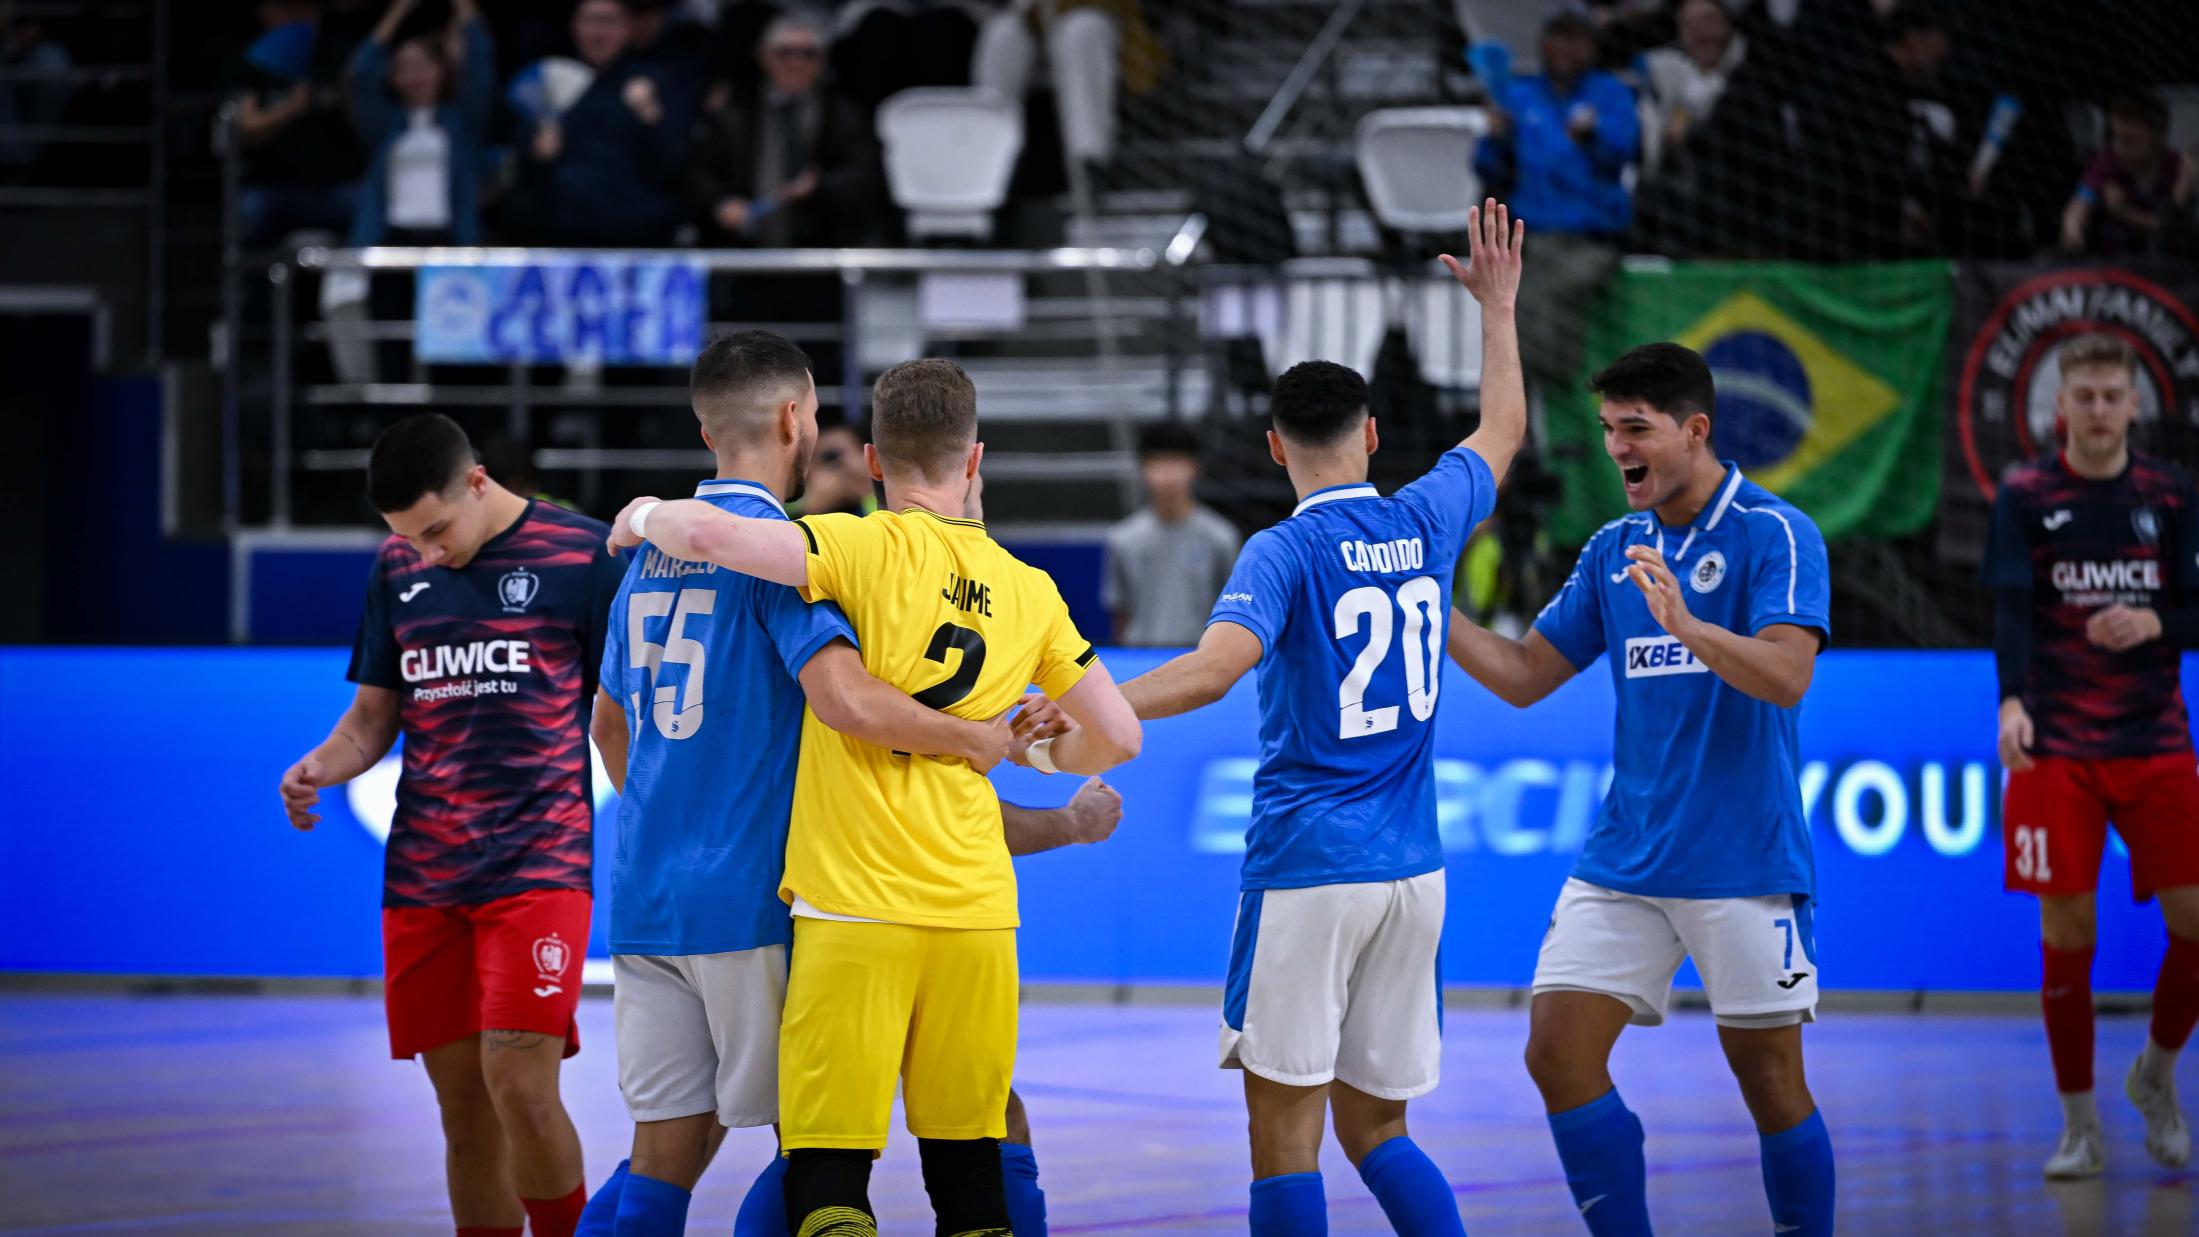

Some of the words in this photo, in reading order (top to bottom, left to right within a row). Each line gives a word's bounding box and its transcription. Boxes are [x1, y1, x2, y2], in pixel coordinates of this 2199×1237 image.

[942, 572, 992, 618] JAIME
[2052, 560, 2161, 591] GLIWICE
[400, 639, 531, 682] GLIWICE
[628, 588, 717, 740] 55
[901, 621, 987, 732] 2
[1333, 575, 1442, 740] 20
[473, 679, 499, 698] jest
[501, 680, 517, 693] tu
[2014, 824, 2052, 882] 31
[1773, 918, 1793, 970] 7
